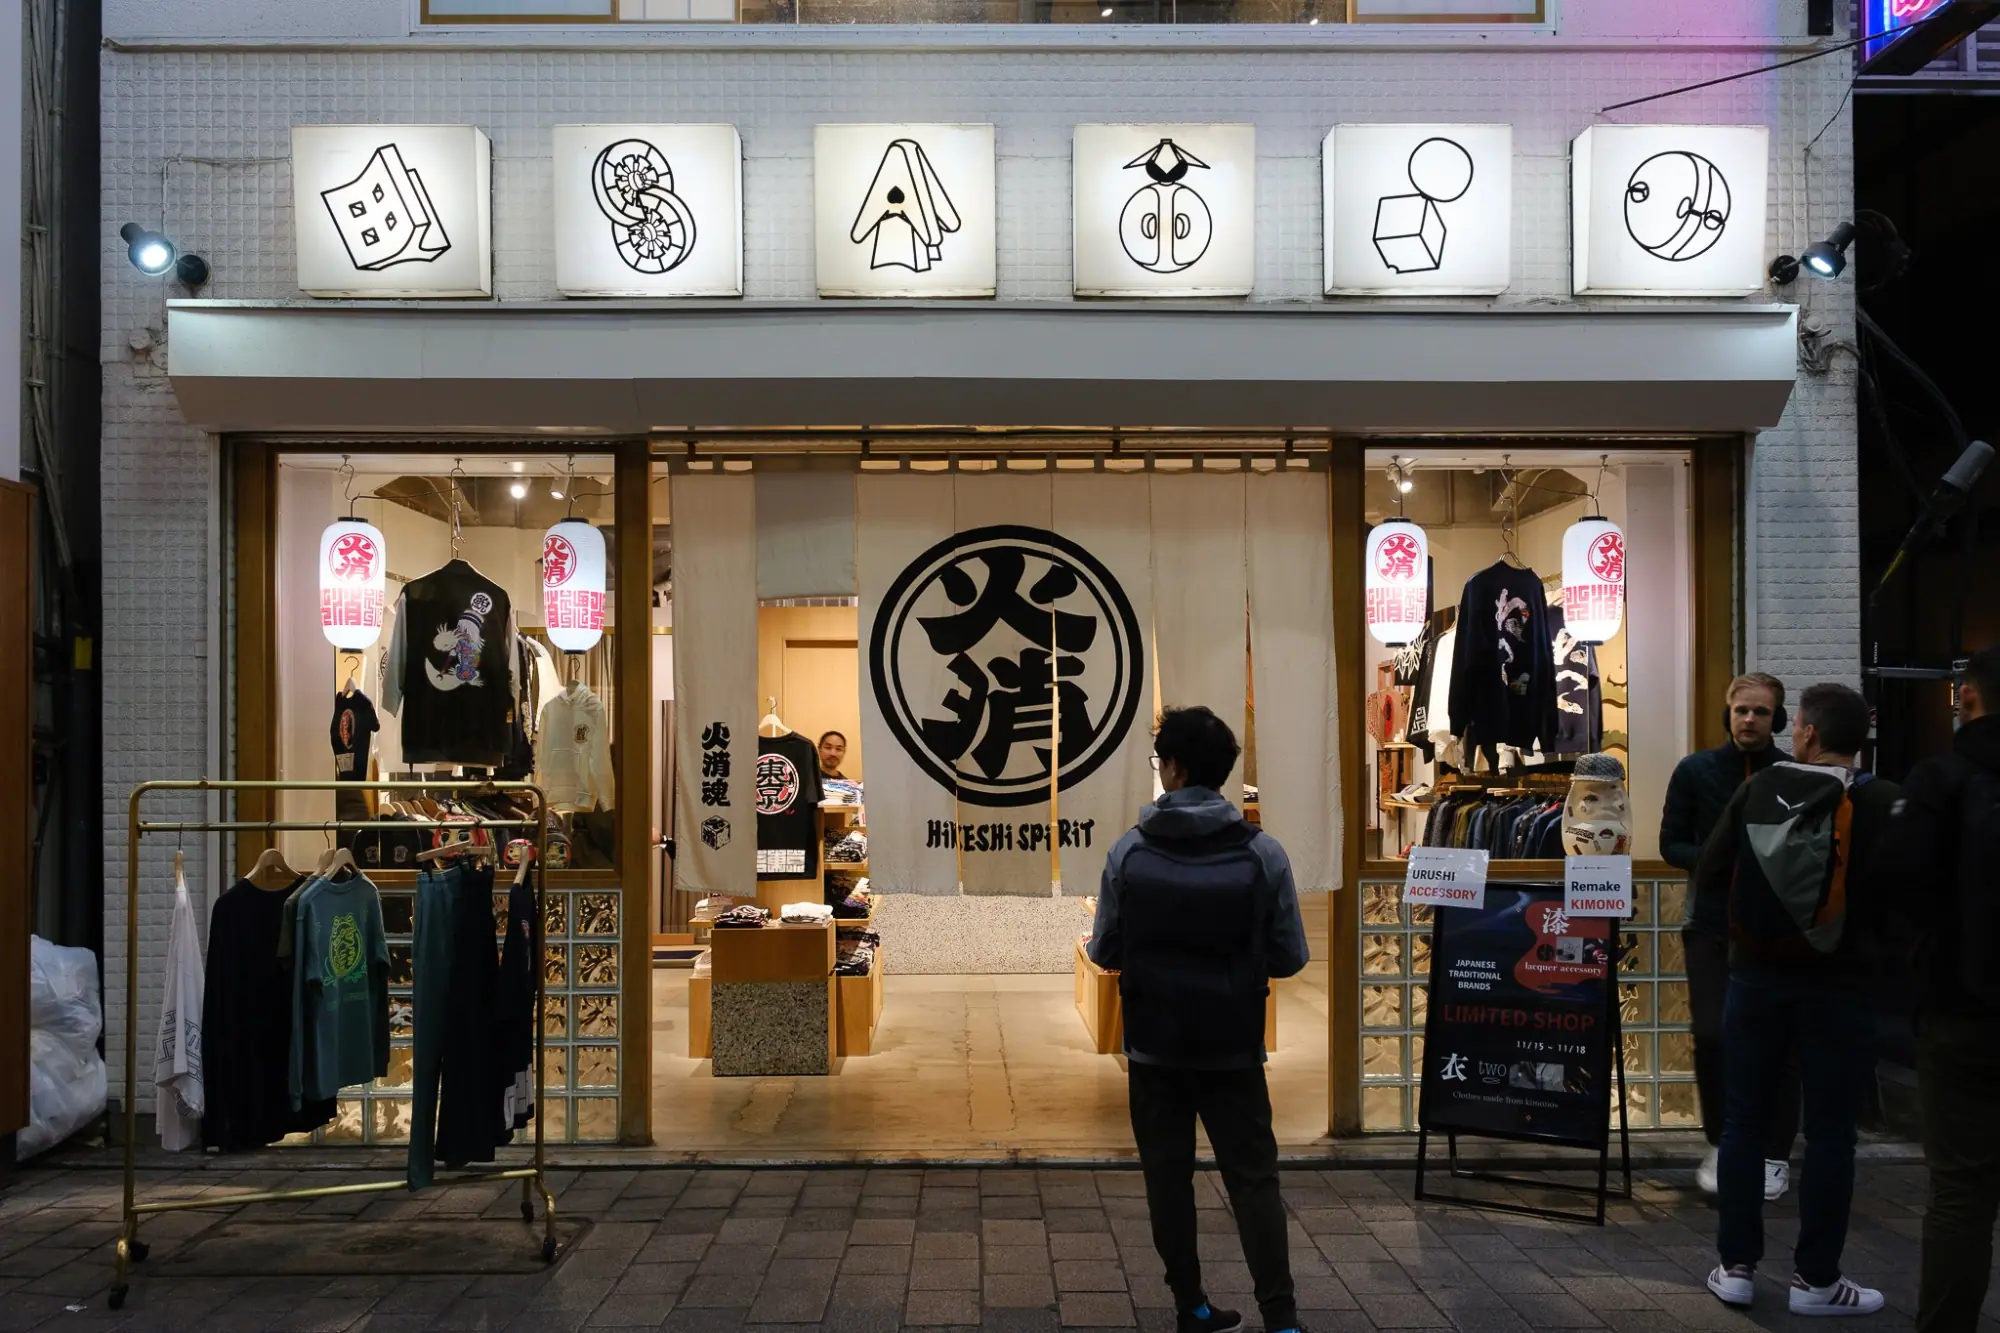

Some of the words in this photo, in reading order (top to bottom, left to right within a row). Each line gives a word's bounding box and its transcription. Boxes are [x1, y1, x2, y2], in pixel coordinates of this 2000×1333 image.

[1412, 869, 1455, 881] URUSHI
[1409, 886, 1477, 900] ACCESSORY
[1571, 881, 1621, 892] Remake
[1571, 899, 1625, 910] KIMONO
[1542, 907, 1570, 935] 漆
[1455, 959, 1497, 969] JAPANESE
[1524, 961, 1558, 973] lacquer
[1560, 965, 1602, 977] accessory
[1449, 969, 1502, 981] TRADITIONAL
[1458, 981, 1491, 991] BRANDS
[1444, 1004, 1527, 1026] LIMITED
[1534, 1011, 1596, 1032] SHOP
[1440, 1052, 1469, 1082] 衣
[1478, 1060, 1507, 1077] two
[1452, 1090, 1481, 1101] Clothes
[1483, 1094, 1504, 1104] made
[1505, 1096, 1523, 1106] from
